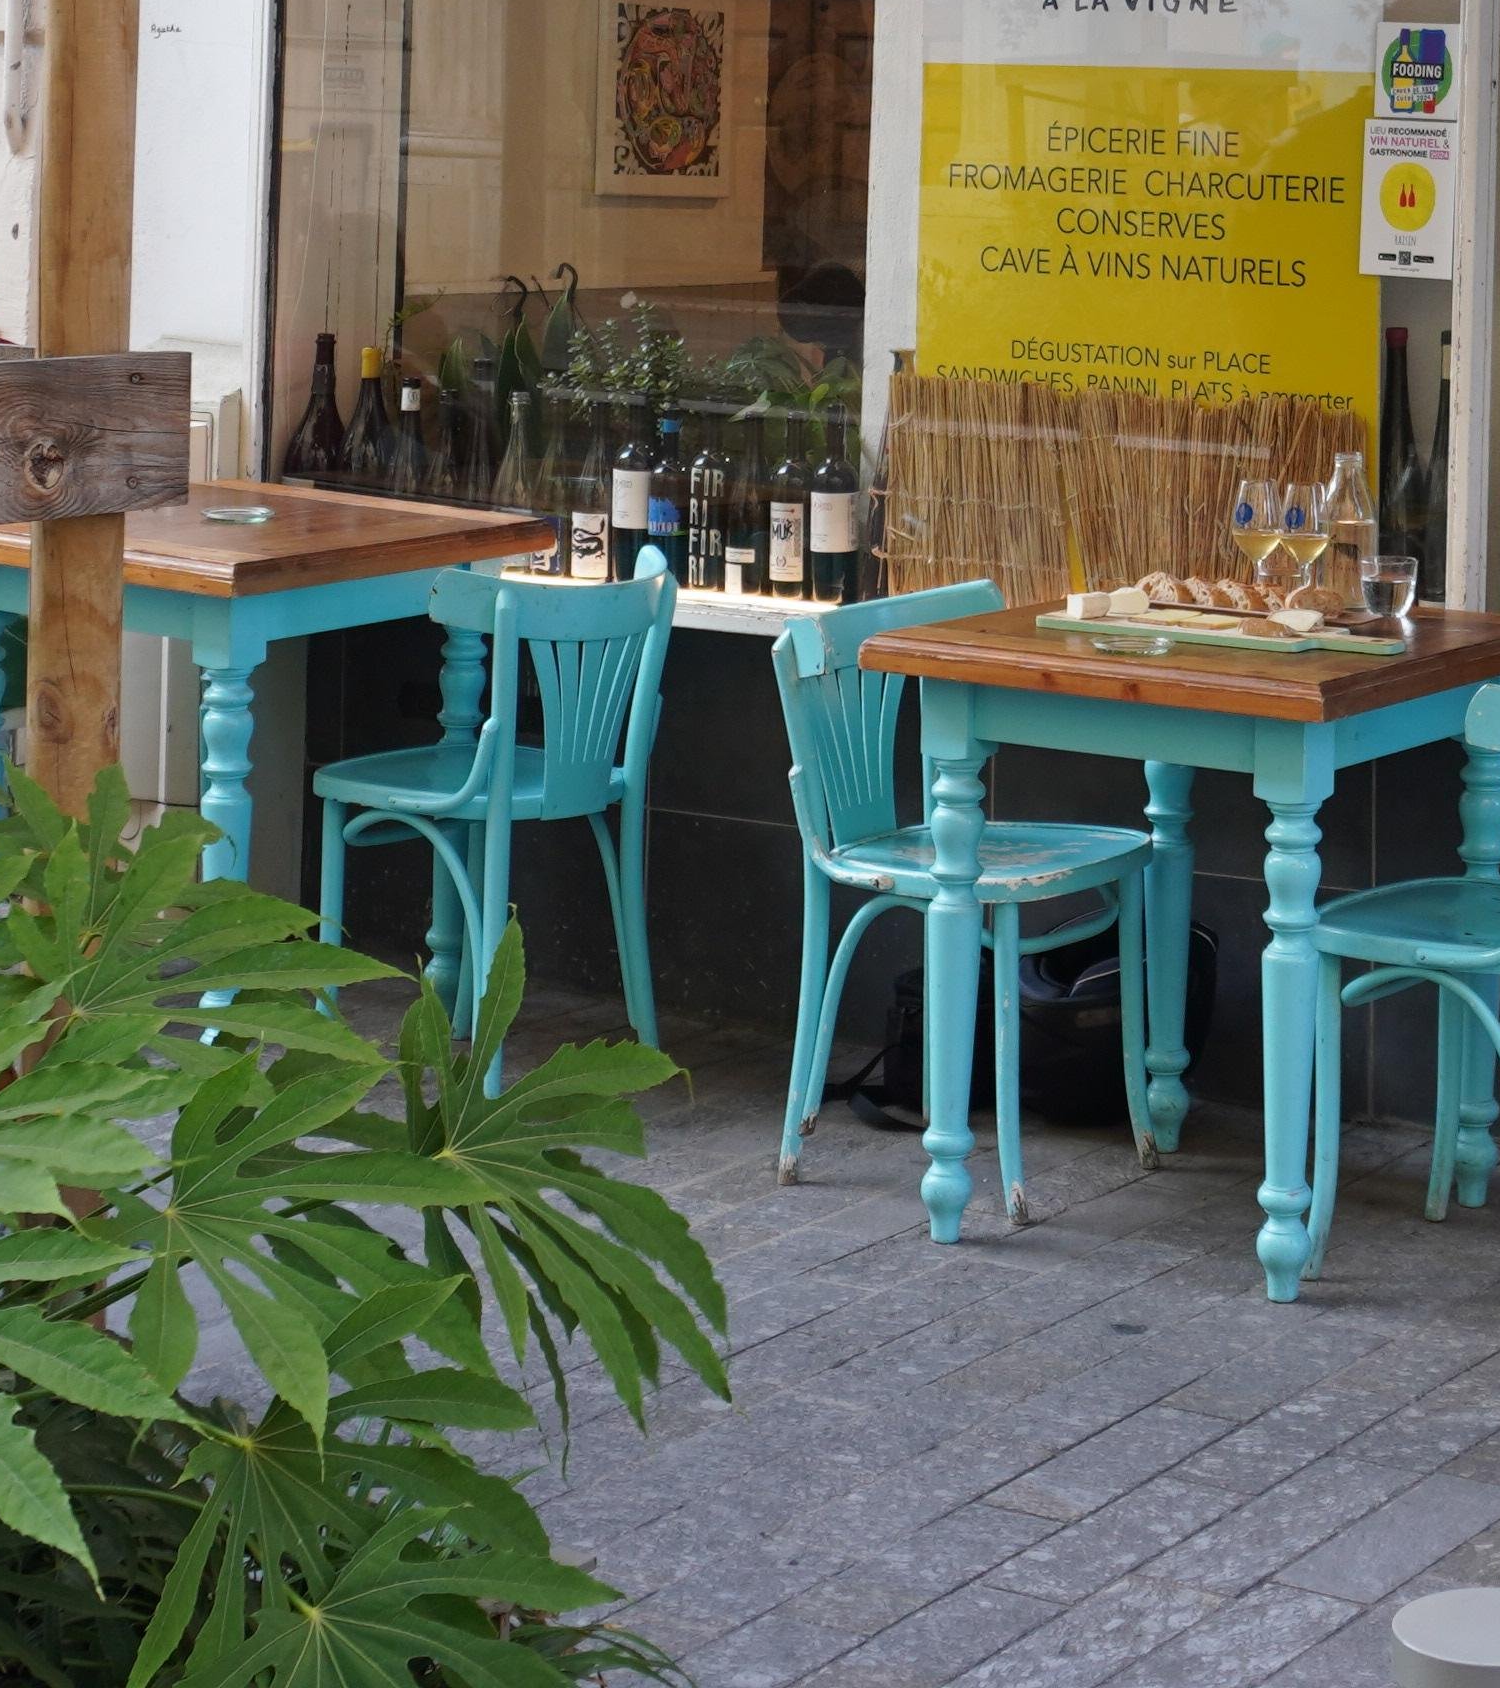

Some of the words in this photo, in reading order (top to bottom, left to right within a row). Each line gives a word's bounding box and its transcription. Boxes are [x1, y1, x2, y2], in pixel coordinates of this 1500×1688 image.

[1392, 62, 1442, 79] FOODING
[1047, 121, 1166, 155] ÉPICERIE
[1176, 129, 1240, 158] FINE
[1370, 126, 1387, 135] LIEU
[1387, 126, 1448, 138] RECOMMANDÉ
[1370, 135, 1388, 146] VIN
[1390, 137, 1440, 149] NATUREL
[1369, 147, 1428, 158] GASTRONOMIE
[948, 163, 1128, 196] FROMAGERIE
[1144, 169, 1346, 204] CHARCUTERIE
[1056, 208, 1227, 241] CONSERVES
[980, 245, 1051, 275] CAVE
[1058, 243, 1080, 276] À
[1086, 249, 1151, 280] VINS
[1161, 254, 1308, 288] NATURELS
[1010, 336, 1161, 368] DÉGUSTATION
[1166, 353, 1197, 370] sur
[1203, 351, 1272, 375] PLACE
[690, 466, 724, 497] FIR
[689, 497, 708, 527] RI
[688, 527, 723, 557] FIR
